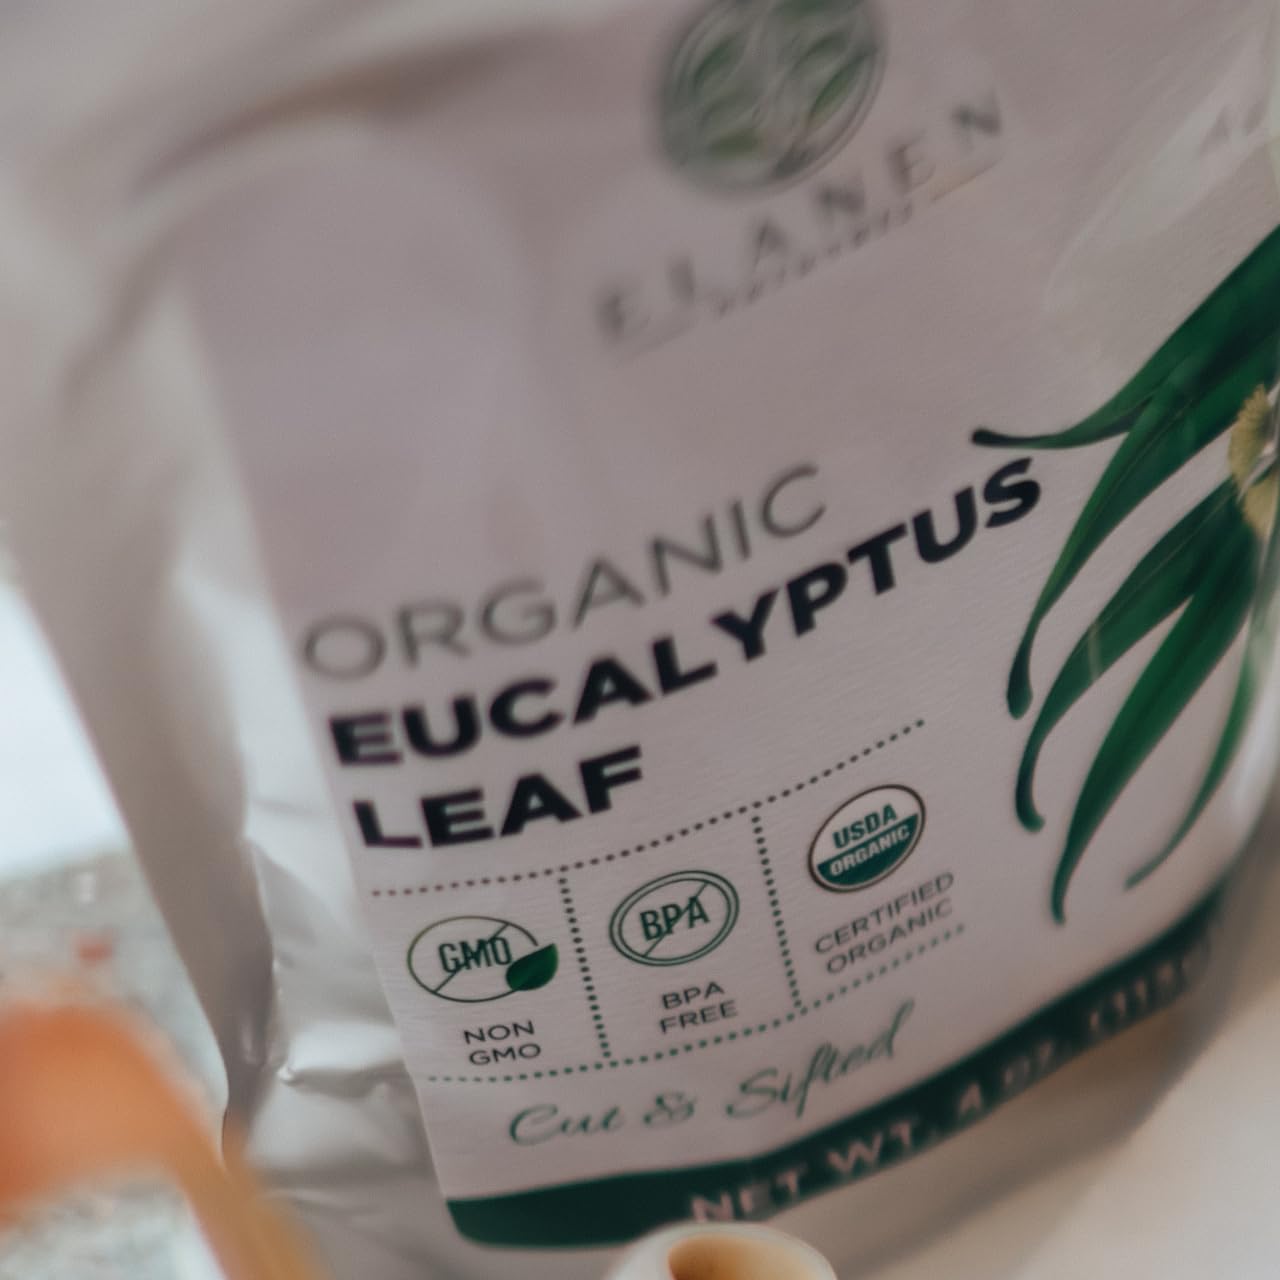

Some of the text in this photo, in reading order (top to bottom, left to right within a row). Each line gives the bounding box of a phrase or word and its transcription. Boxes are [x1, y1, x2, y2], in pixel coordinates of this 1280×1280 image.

[303, 463, 827, 681] ORGANIC
[329, 457, 1042, 766] EUCALYPTUS
[353, 745, 643, 850] LEAF
[829, 824, 911, 877] ORGANIC
[832, 803, 897, 849] USDA
[639, 896, 710, 942] BPA
[814, 872, 954, 954] CERTIFIED
[826, 898, 953, 974] ORGANIC
[437, 936, 513, 974] GMO
[659, 1000, 738, 1034] FREE
[662, 981, 726, 1010] BPA
[463, 1020, 536, 1045] NON
[468, 1043, 542, 1066] GMO
[509, 998, 917, 1148] Cut & Sifted
[689, 1161, 807, 1223] NET
